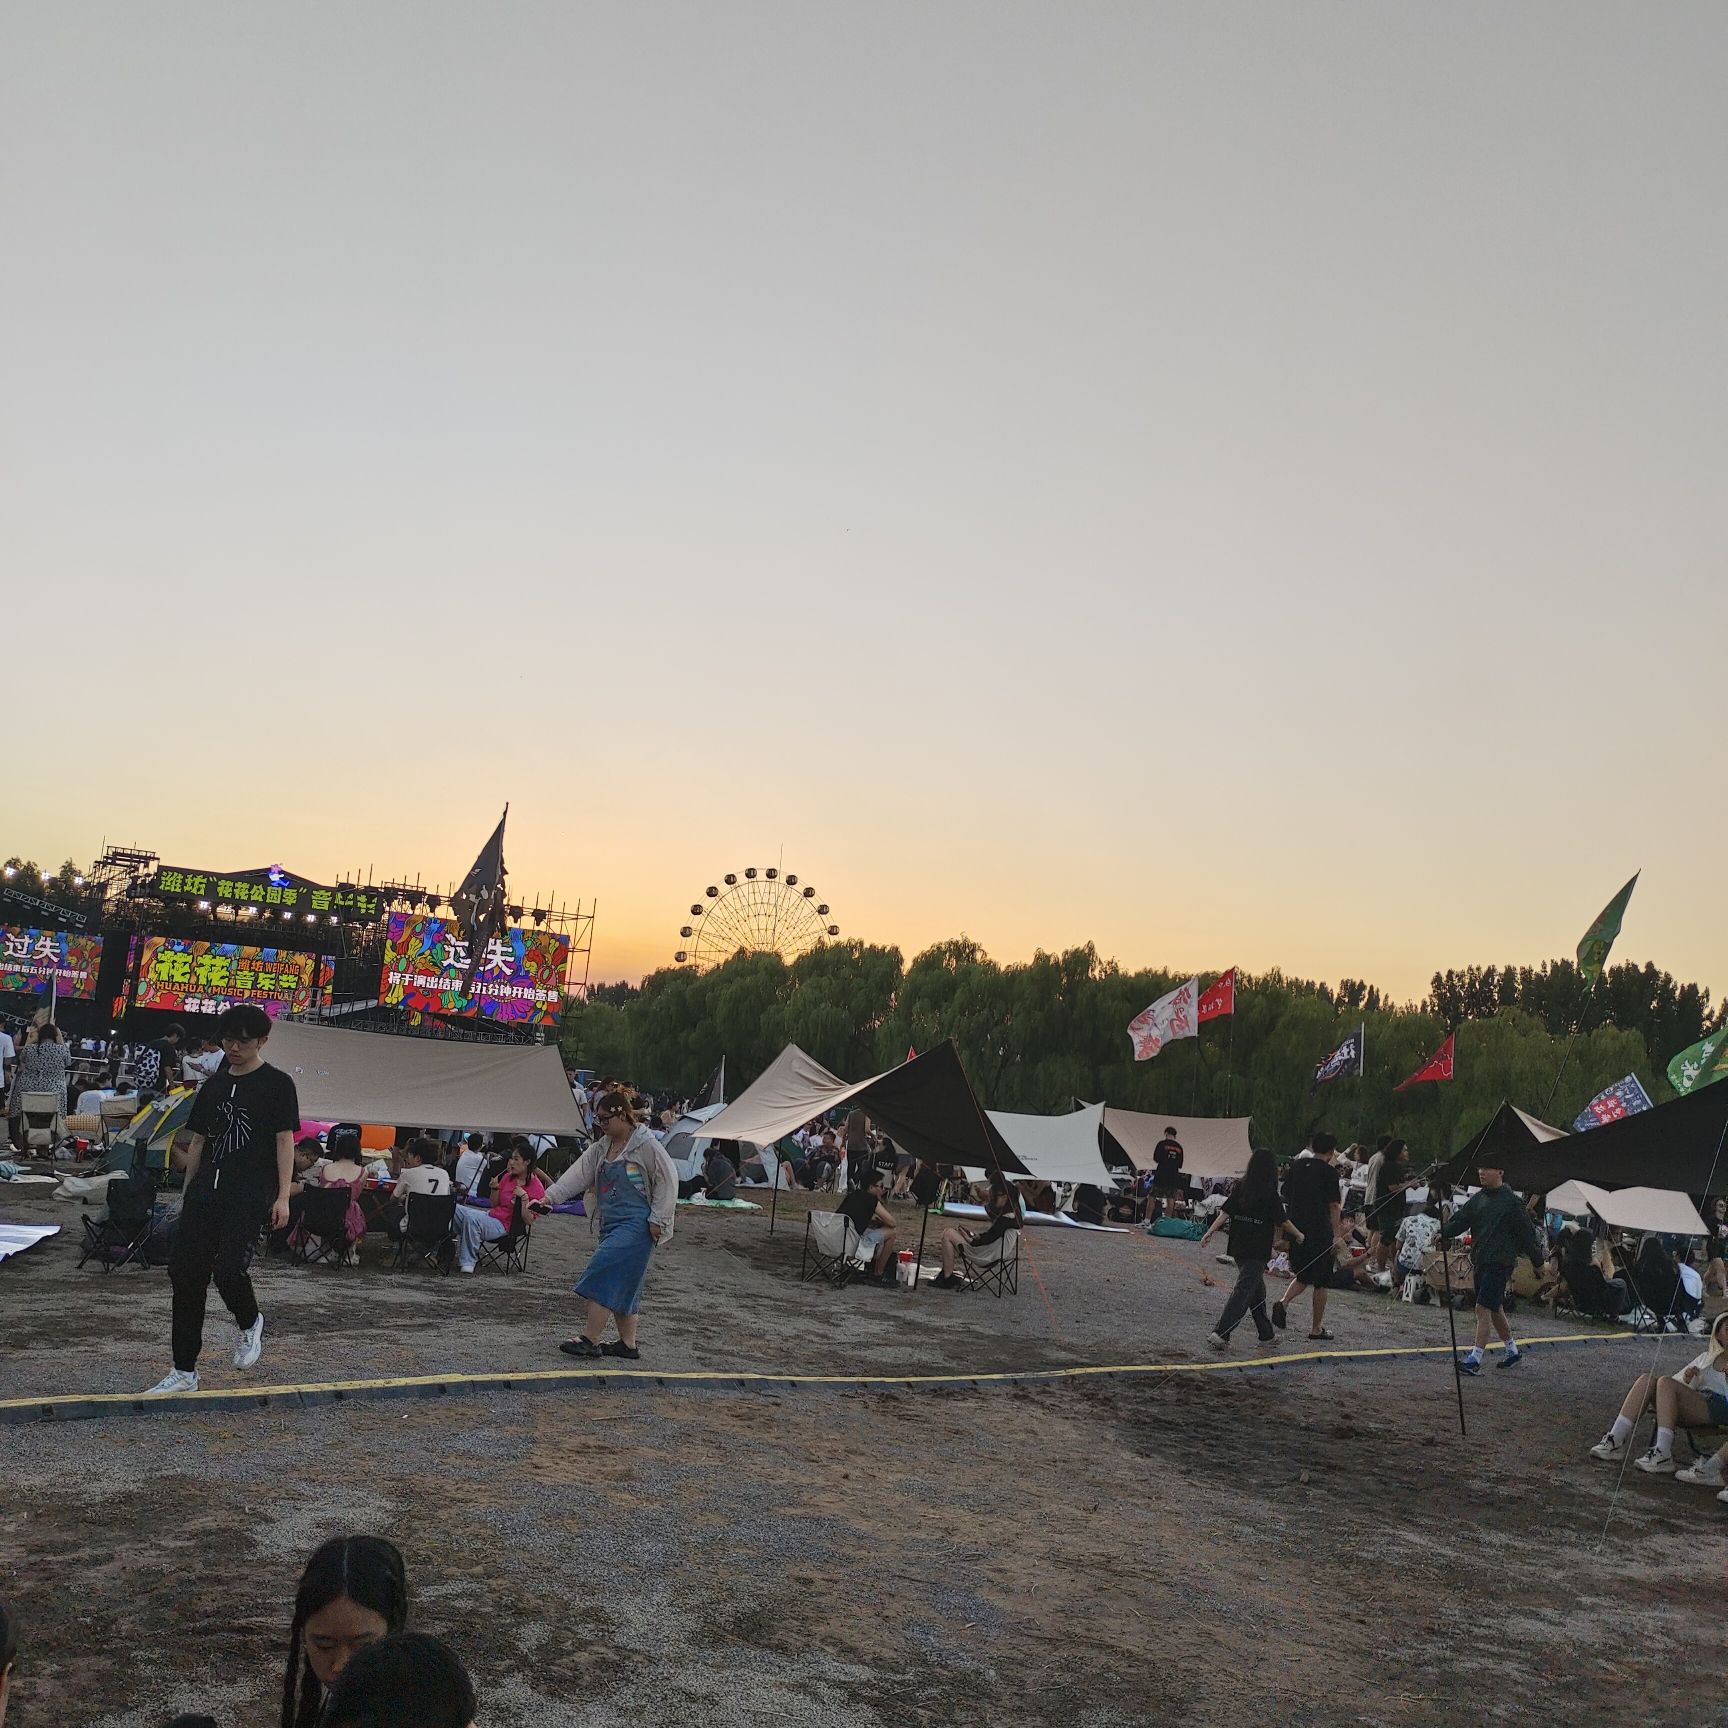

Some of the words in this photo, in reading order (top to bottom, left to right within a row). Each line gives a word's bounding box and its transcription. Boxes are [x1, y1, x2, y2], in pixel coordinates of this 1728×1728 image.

[3, 932, 61, 963] 过失
[156, 950, 231, 987] 花花
[265, 962, 300, 975] WEIFANG
[235, 970, 299, 990] 音乐节
[156, 981, 204, 993] HUAHUA
[212, 985, 245, 997] MUSIC
[251, 989, 292, 1000] FESTIVA
[428, 1178, 440, 1194] 7
